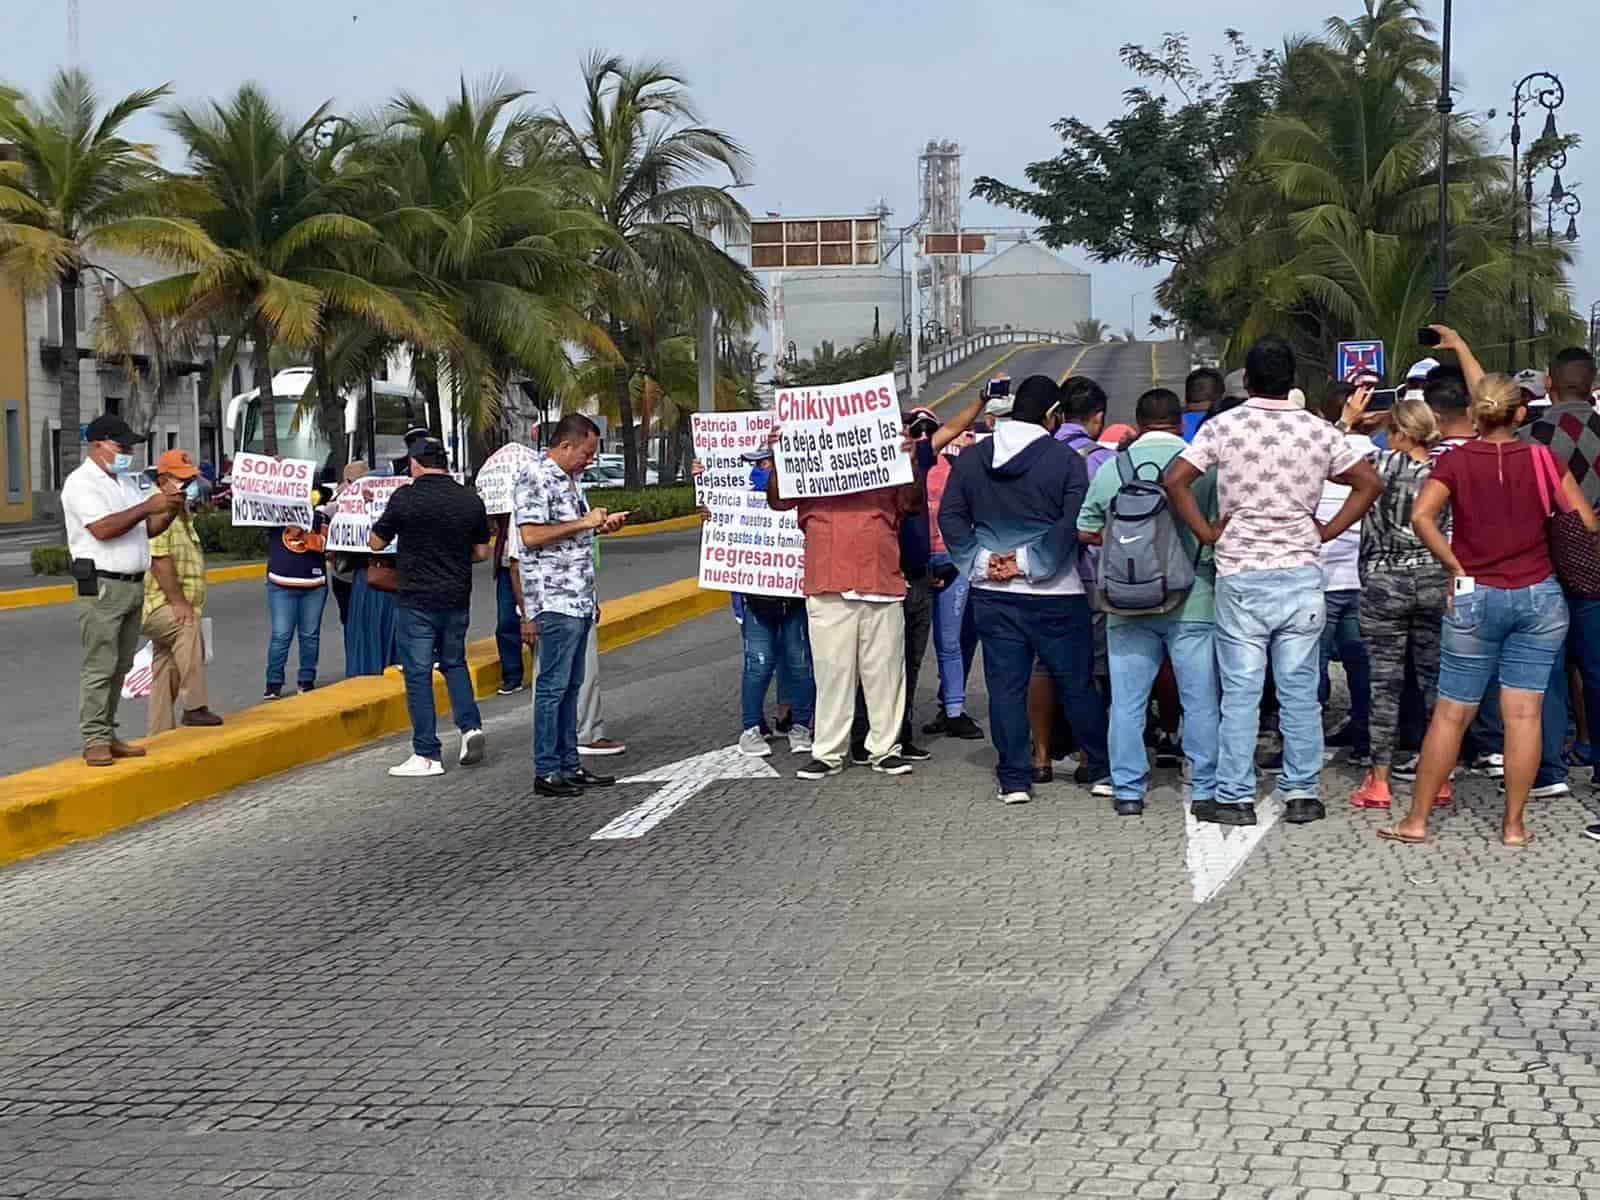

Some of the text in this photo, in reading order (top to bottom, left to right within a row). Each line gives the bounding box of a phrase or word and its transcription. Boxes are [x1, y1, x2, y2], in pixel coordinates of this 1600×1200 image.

[777, 386, 891, 426] Chikiyunes
[694, 416, 737, 432] Patricia
[695, 433, 718, 451] deja
[721, 433, 735, 448] de
[738, 435, 757, 447] ser
[793, 429, 816, 457] deja
[818, 429, 833, 450] de
[836, 425, 872, 449] meter
[878, 419, 898, 440] las
[241, 458, 308, 479] SOMOS
[706, 454, 744, 472] piensa
[784, 443, 897, 473] manos! asustas en
[233, 475, 309, 498] COMERCIANTES
[696, 472, 745, 489] dejastes
[796, 465, 890, 495] el ayuntamiento
[234, 497, 248, 520] NO
[707, 491, 742, 506] Patricia
[330, 523, 340, 546] NO
[705, 529, 710, 544] y
[713, 528, 726, 542] los
[728, 532, 753, 546] gastos
[754, 533, 762, 545] de
[763, 533, 775, 546] las
[706, 547, 805, 569] regresanos
[704, 568, 754, 586] nuestro
